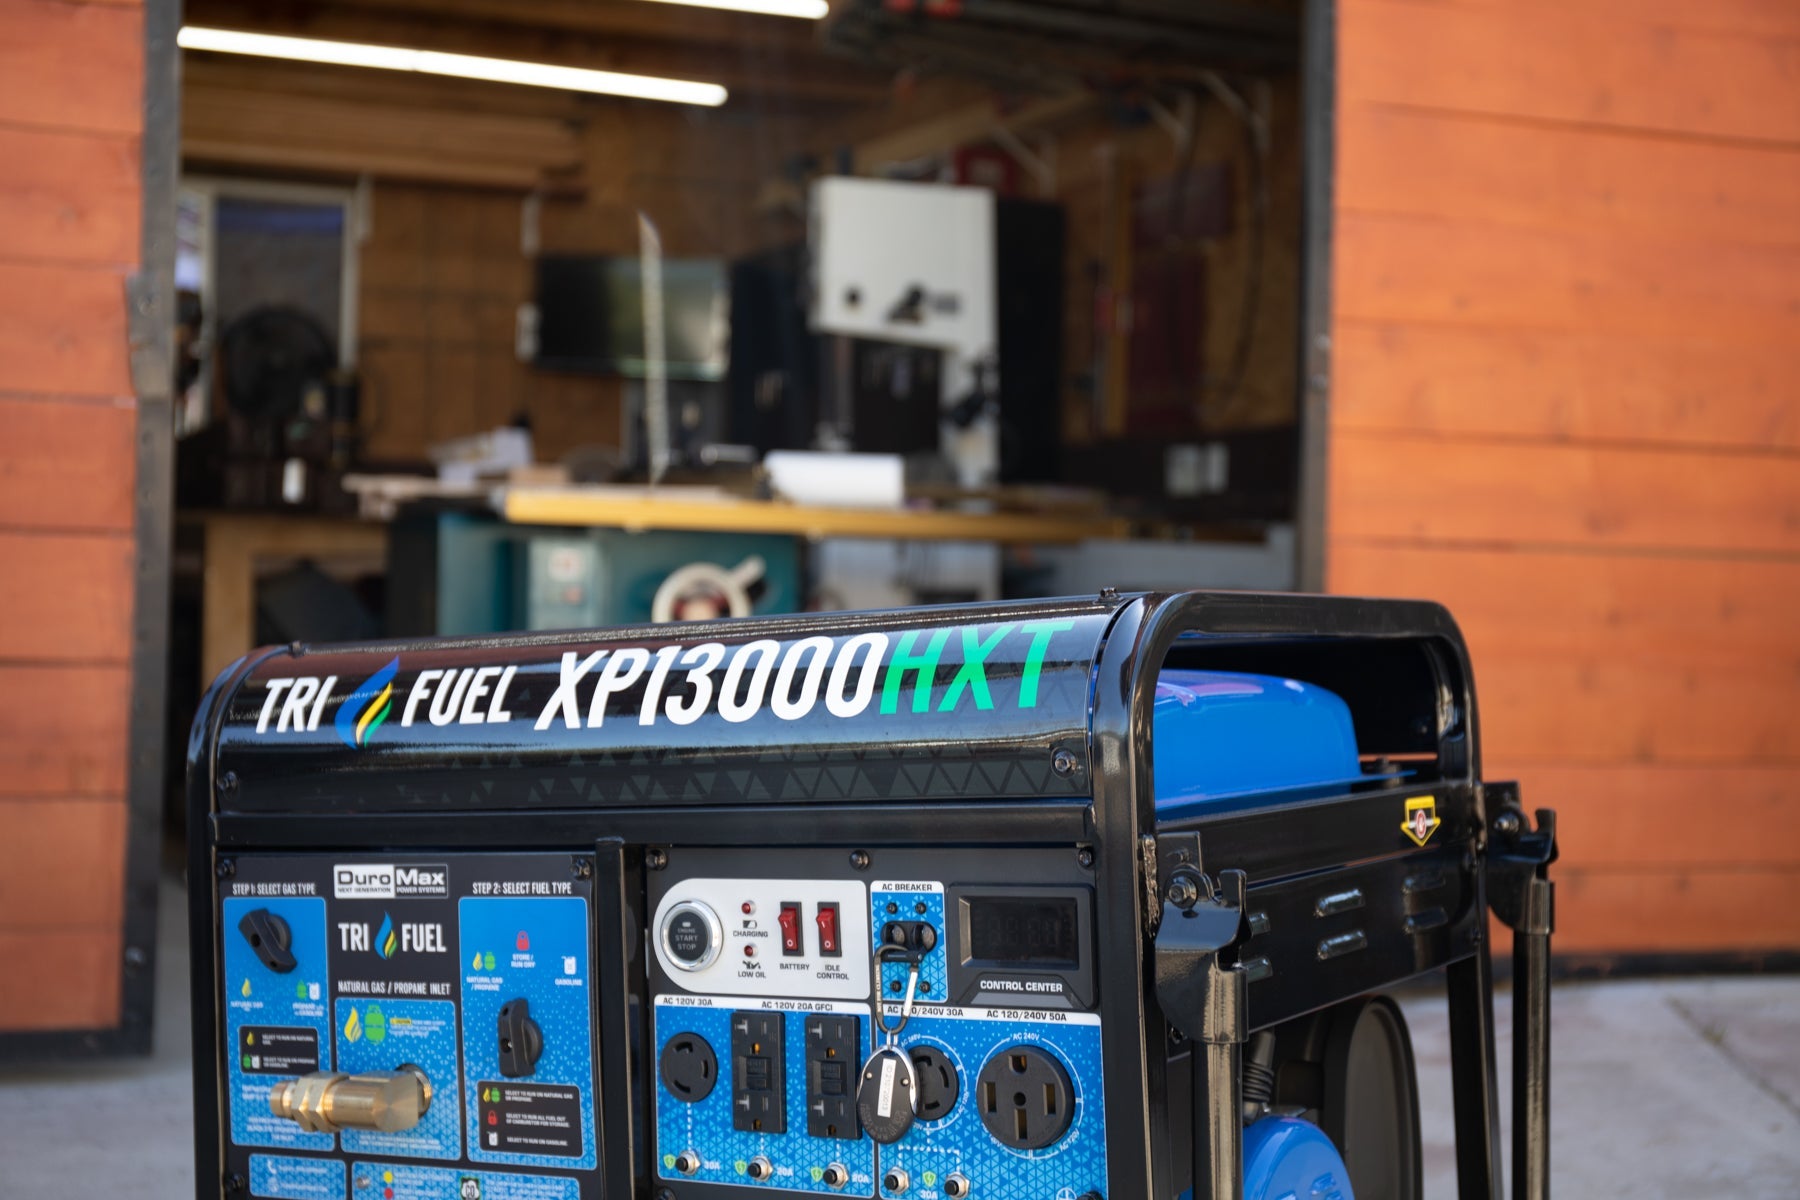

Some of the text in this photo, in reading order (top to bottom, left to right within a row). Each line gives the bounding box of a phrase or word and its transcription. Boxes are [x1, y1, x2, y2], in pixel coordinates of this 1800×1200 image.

[256, 621, 1075, 734] TRI FUEL XP13000HXT
[232, 883, 250, 895] STEP
[255, 883, 282, 896] SELECT
[281, 883, 297, 896] GAS
[297, 883, 316, 896] TYPE
[396, 886, 417, 894] POWER
[472, 882, 572, 895] STEP 2: SELECT FUEL TYPE
[882, 883, 933, 892] AC BREAKER
[338, 923, 447, 953] TRI FUEL
[675, 934, 698, 942] START
[732, 930, 769, 938] CHARGING
[677, 943, 697, 951] STOP
[779, 963, 810, 971] BATTERY
[824, 964, 840, 972] IDLE
[737, 971, 767, 979] LOW OIL
[816, 972, 849, 981] CONTROL
[337, 980, 451, 996] NATURAL GAS / PROPANE INLET
[980, 980, 1063, 993] CONTROL CENTER
[663, 997, 713, 1007] AC 120V 30A
[761, 1001, 833, 1011] AC 120V 20A GFCI
[887, 1005, 964, 1017] AC 0/240V 30A
[986, 1010, 1067, 1022] AC 120/240V 50A
[1012, 1032, 1040, 1042] AC 240V
[1059, 1140, 1069, 1153] AC
[703, 1161, 721, 1171] 30A
[776, 1166, 794, 1177] 20A
[851, 1173, 870, 1184] 20A
[919, 1189, 938, 1200] 30A
